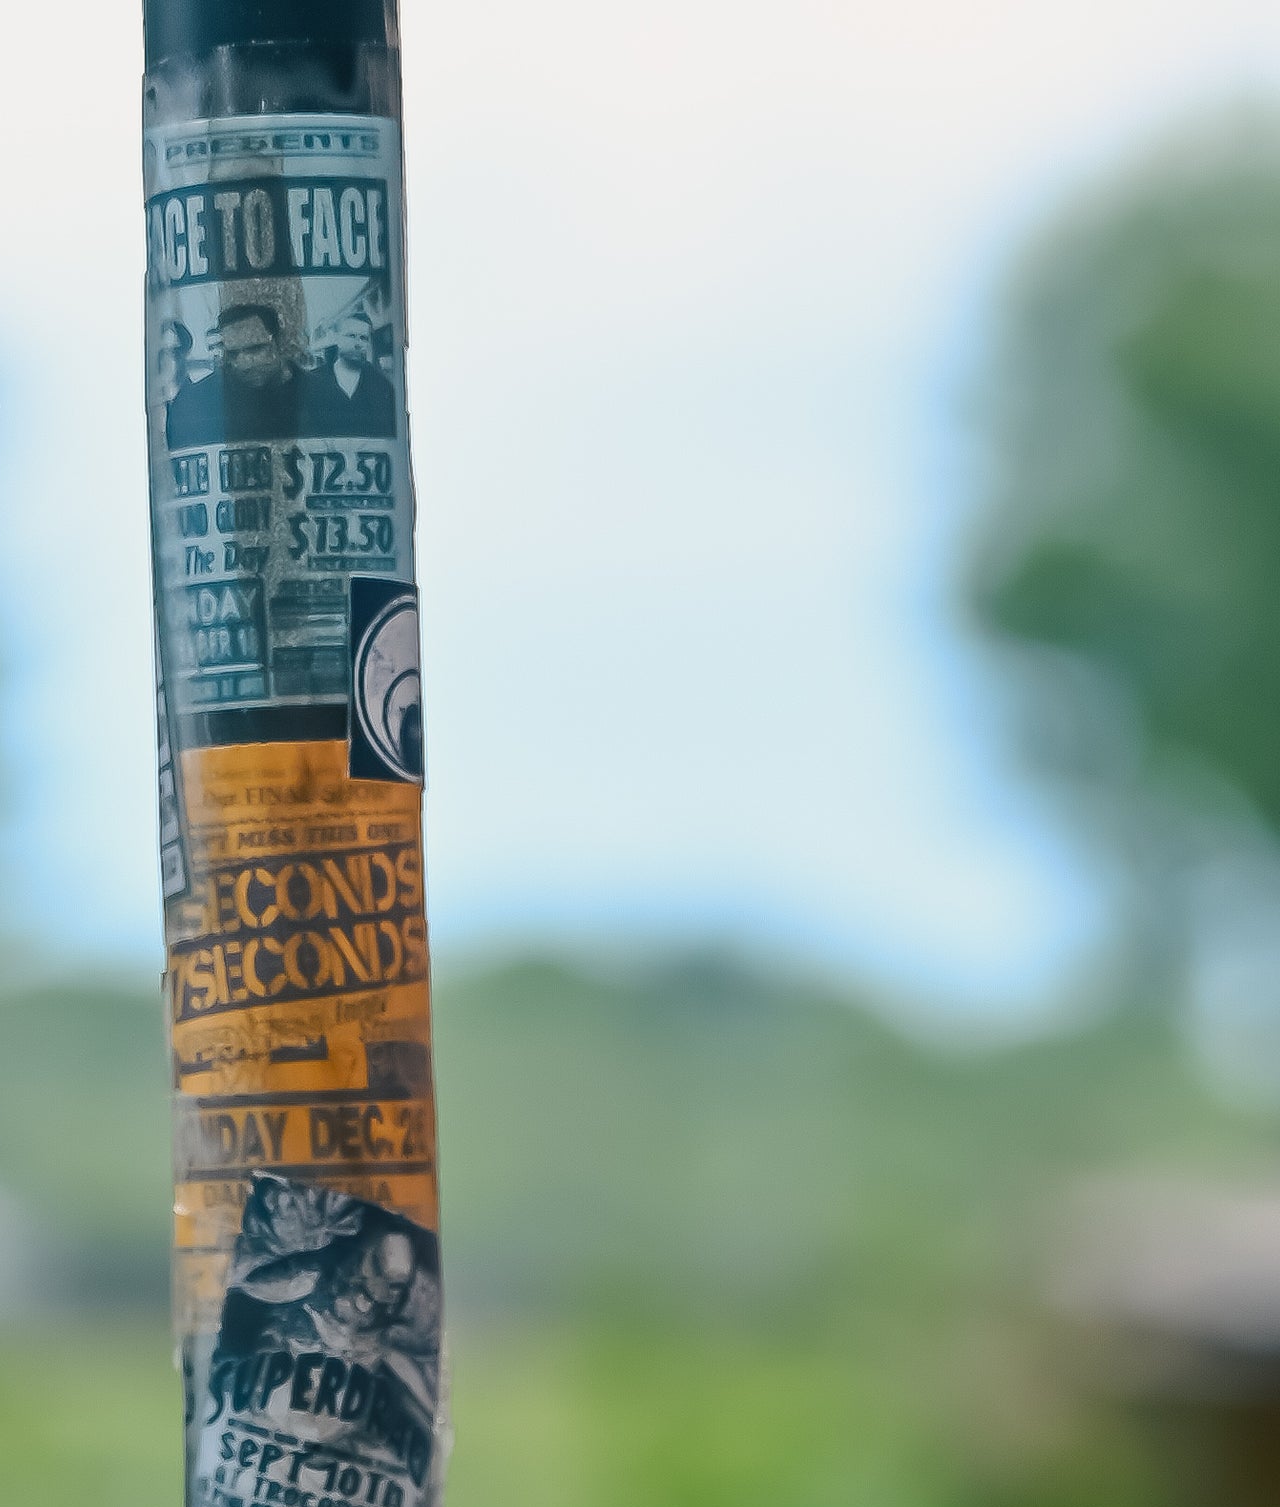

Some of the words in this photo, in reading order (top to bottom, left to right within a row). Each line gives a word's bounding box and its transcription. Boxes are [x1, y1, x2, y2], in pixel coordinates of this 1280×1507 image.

[148, 196, 209, 283] ACE
[214, 187, 274, 272] TO
[287, 187, 385, 268] FACE
[281, 444, 392, 500] $12.50
[184, 545, 215, 576] The
[288, 510, 394, 560] $13.50
[190, 849, 422, 933] ECONDS
